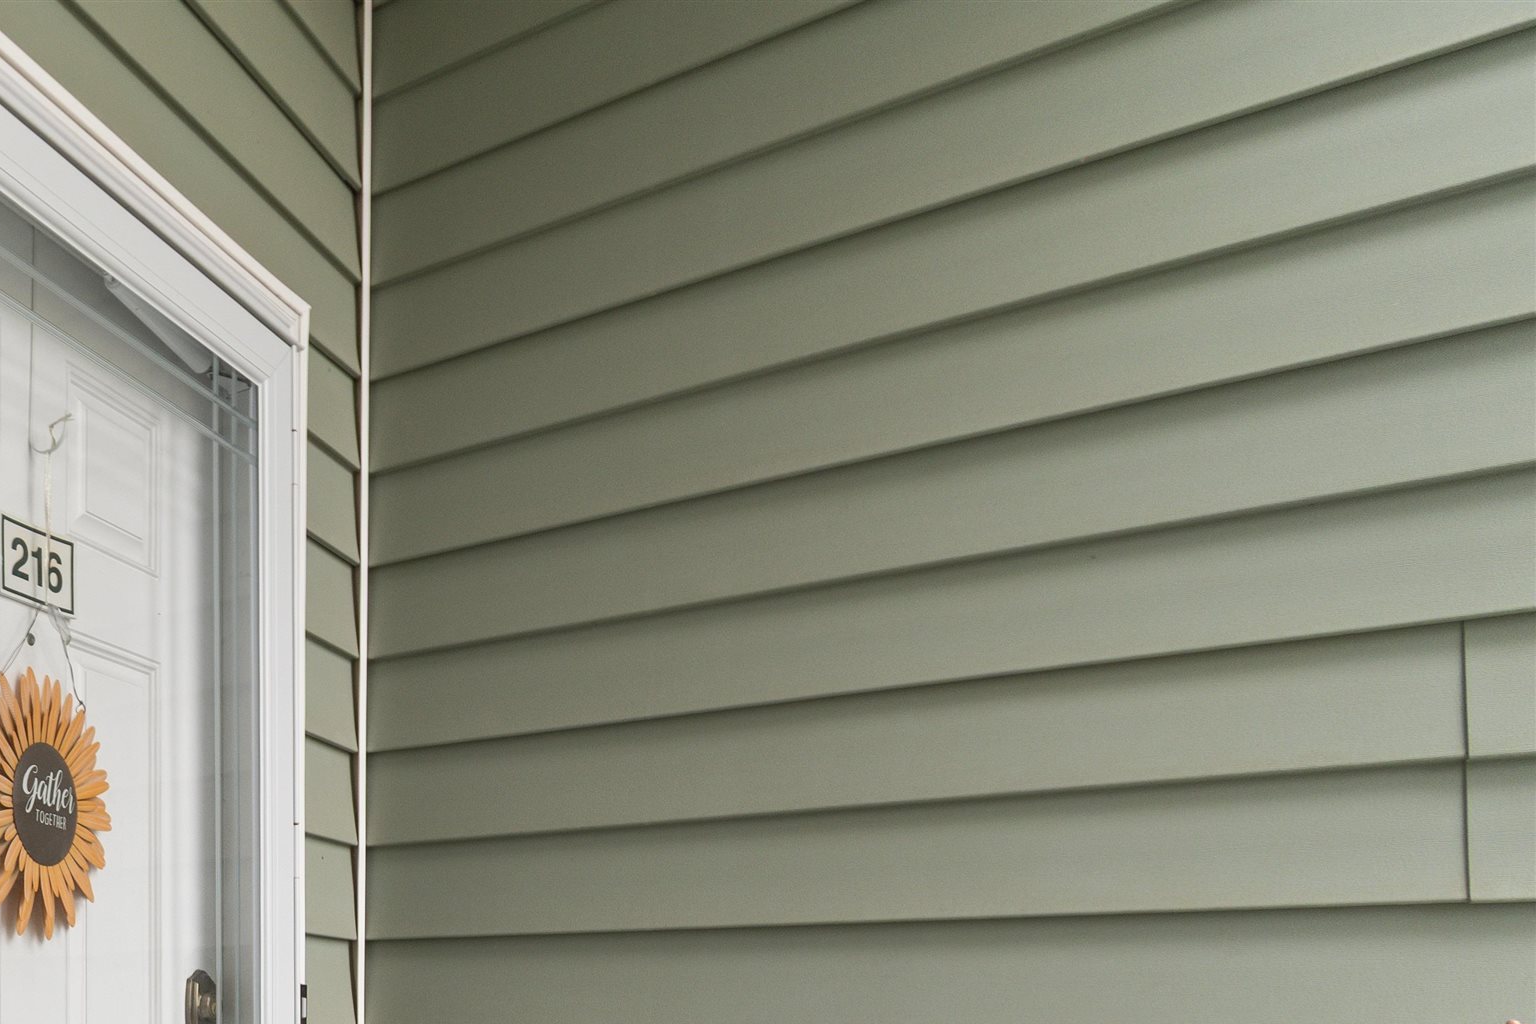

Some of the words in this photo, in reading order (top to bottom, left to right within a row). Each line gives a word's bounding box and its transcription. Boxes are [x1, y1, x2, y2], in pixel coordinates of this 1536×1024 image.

[11, 537, 63, 594] 216
[22, 764, 75, 815] Gather
[36, 808, 66, 831] TOGETHER
